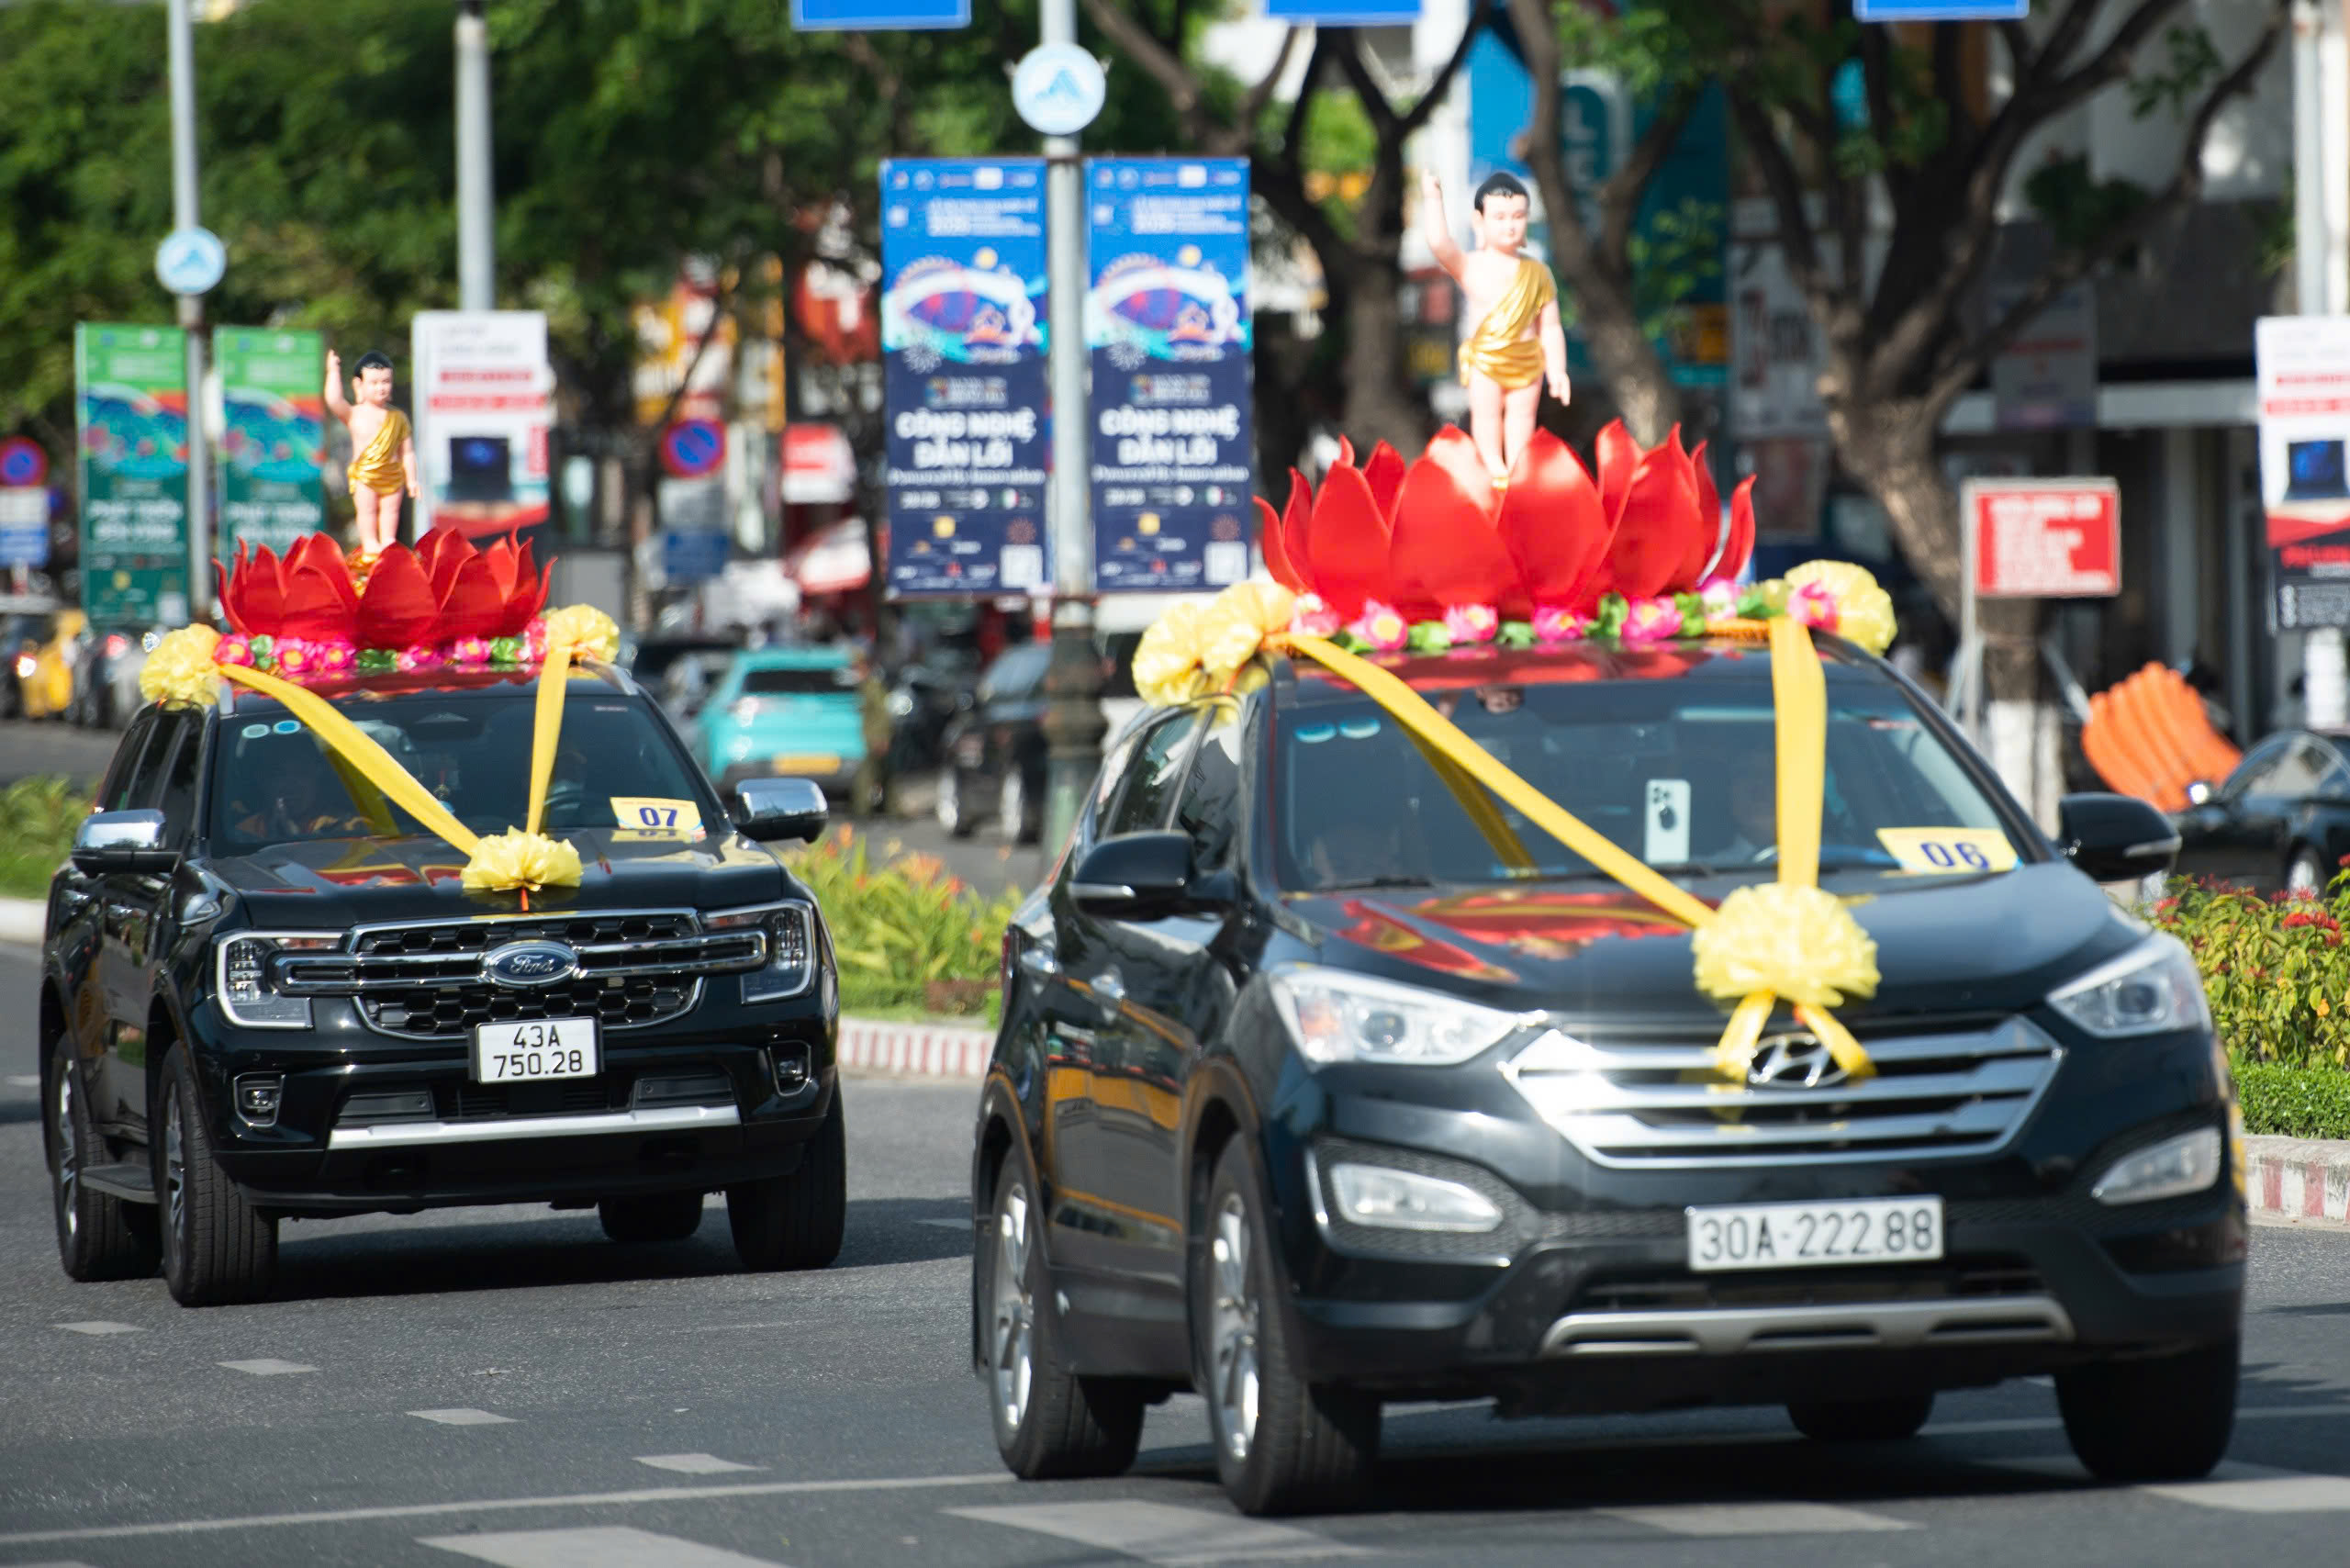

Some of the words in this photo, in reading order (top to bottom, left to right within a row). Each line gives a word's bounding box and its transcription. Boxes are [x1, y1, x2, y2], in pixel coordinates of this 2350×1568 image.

[639, 808, 677, 827] 07
[1920, 843, 1990, 869] 06
[509, 955, 554, 976] Ford
[513, 1025, 560, 1048] 43A
[494, 1050, 583, 1078] 750.28
